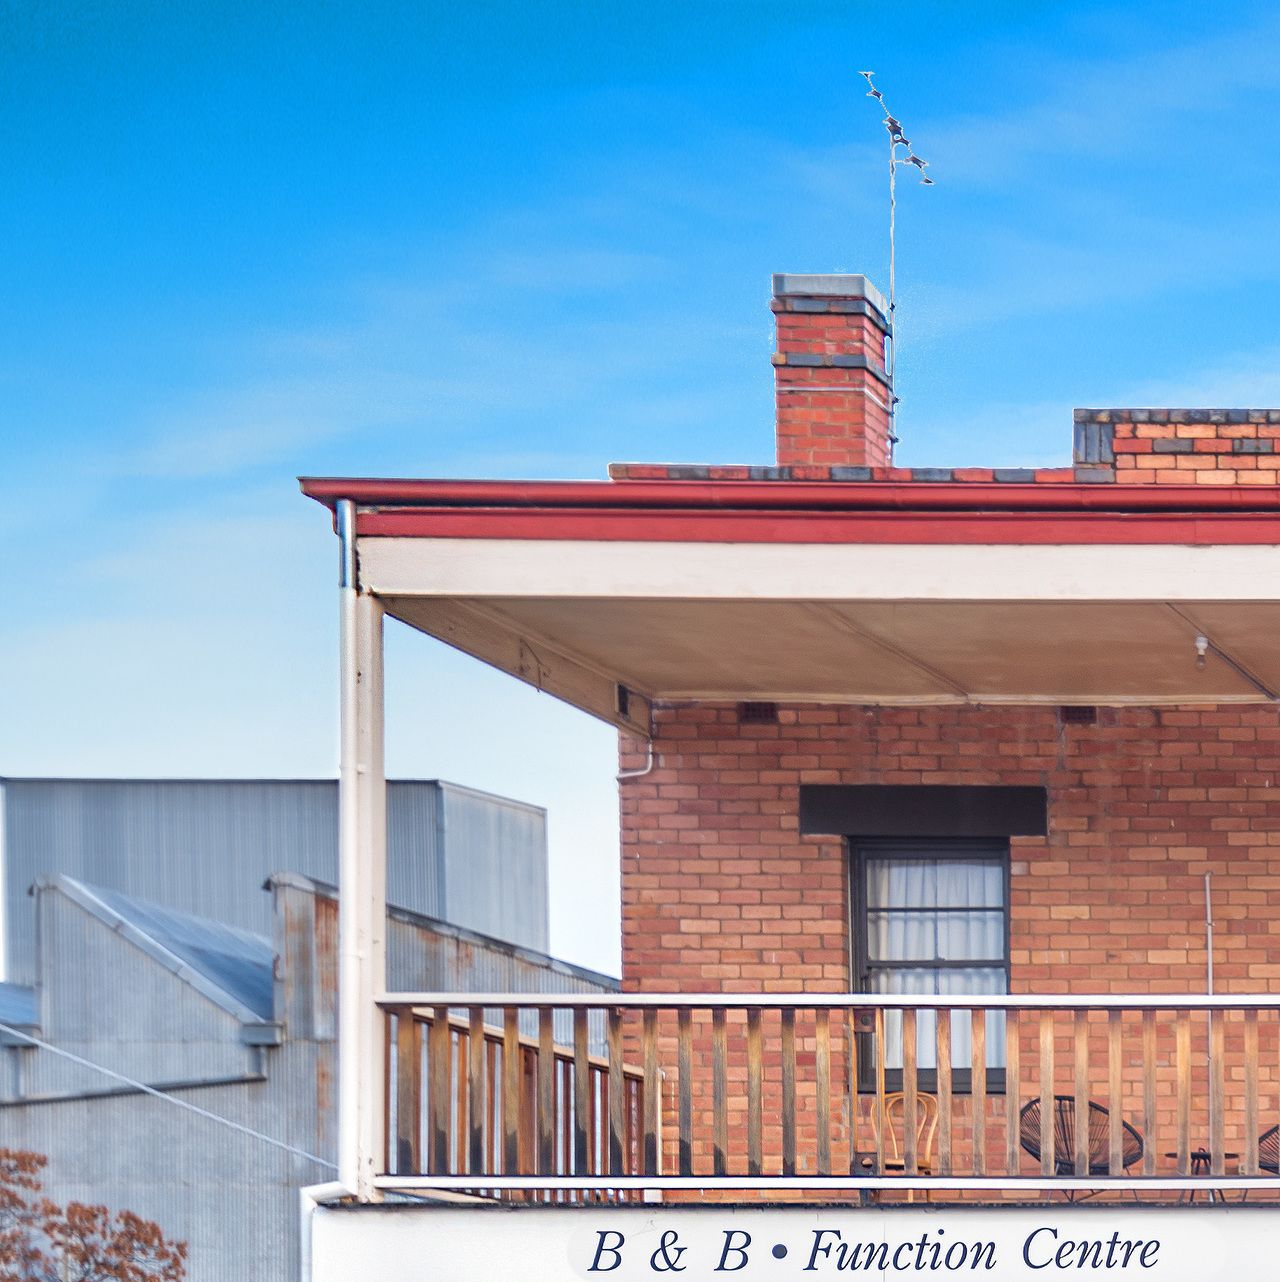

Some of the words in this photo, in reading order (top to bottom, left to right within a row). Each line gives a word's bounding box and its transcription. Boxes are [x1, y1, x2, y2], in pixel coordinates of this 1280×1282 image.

[586, 1230, 626, 1272] B
[649, 1229, 688, 1273] &
[713, 1230, 752, 1272] B
[802, 1228, 997, 1272] Function
[1022, 1227, 1161, 1270] Centre
